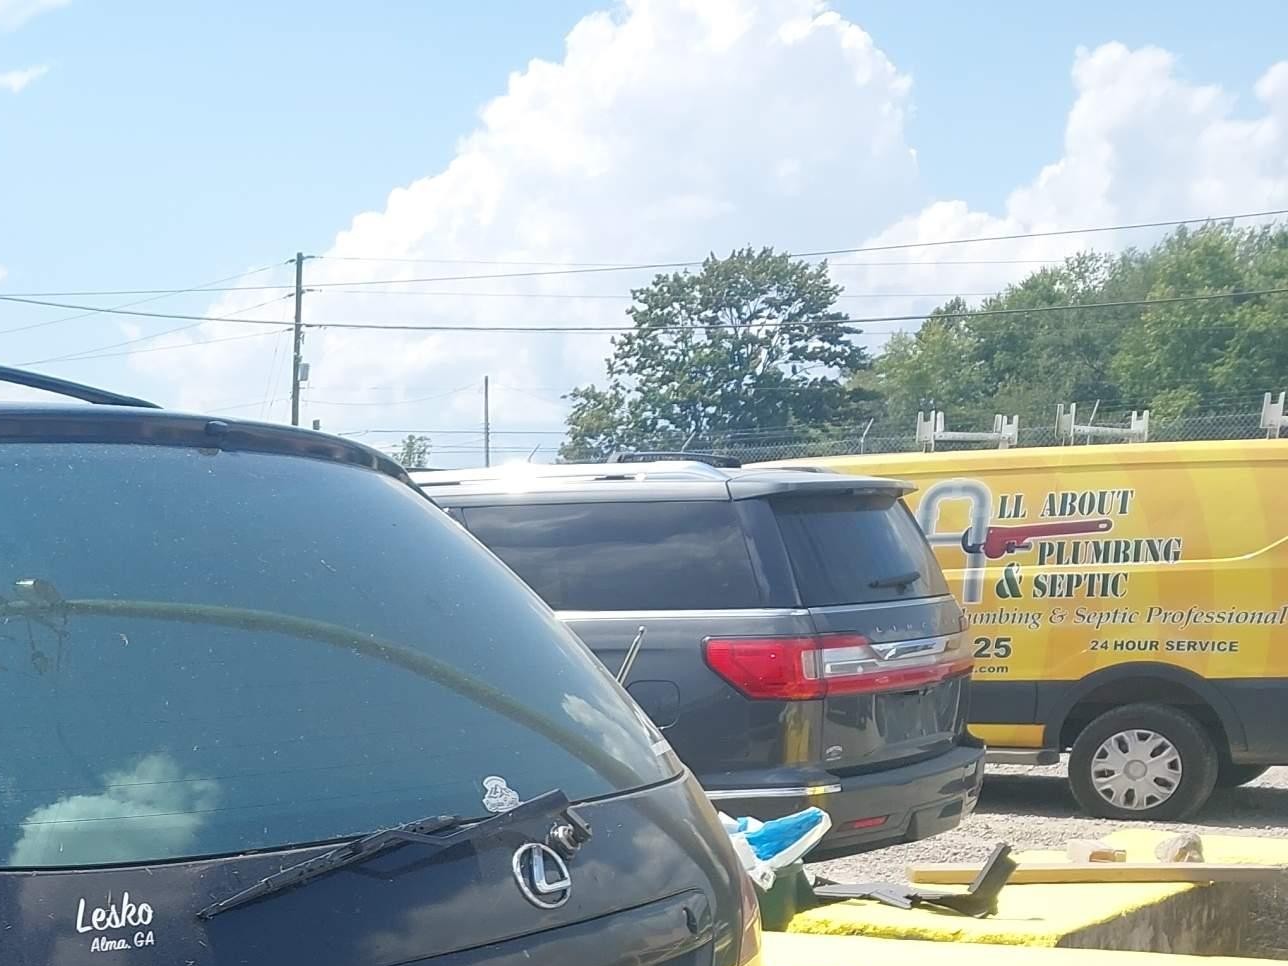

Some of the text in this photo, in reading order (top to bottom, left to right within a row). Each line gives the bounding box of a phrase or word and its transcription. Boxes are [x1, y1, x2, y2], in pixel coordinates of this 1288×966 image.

[1040, 489, 1135, 517] ABOUT
[1038, 538, 1182, 566] PLUMBING
[995, 562, 1129, 599] & SEPTIC
[1049, 608, 1067, 624] &
[1073, 606, 1139, 629] Septic
[1090, 640, 1239, 652] 24 HOUR SERVICE
[76, 891, 153, 933] Lesko
[133, 931, 155, 947] GA
